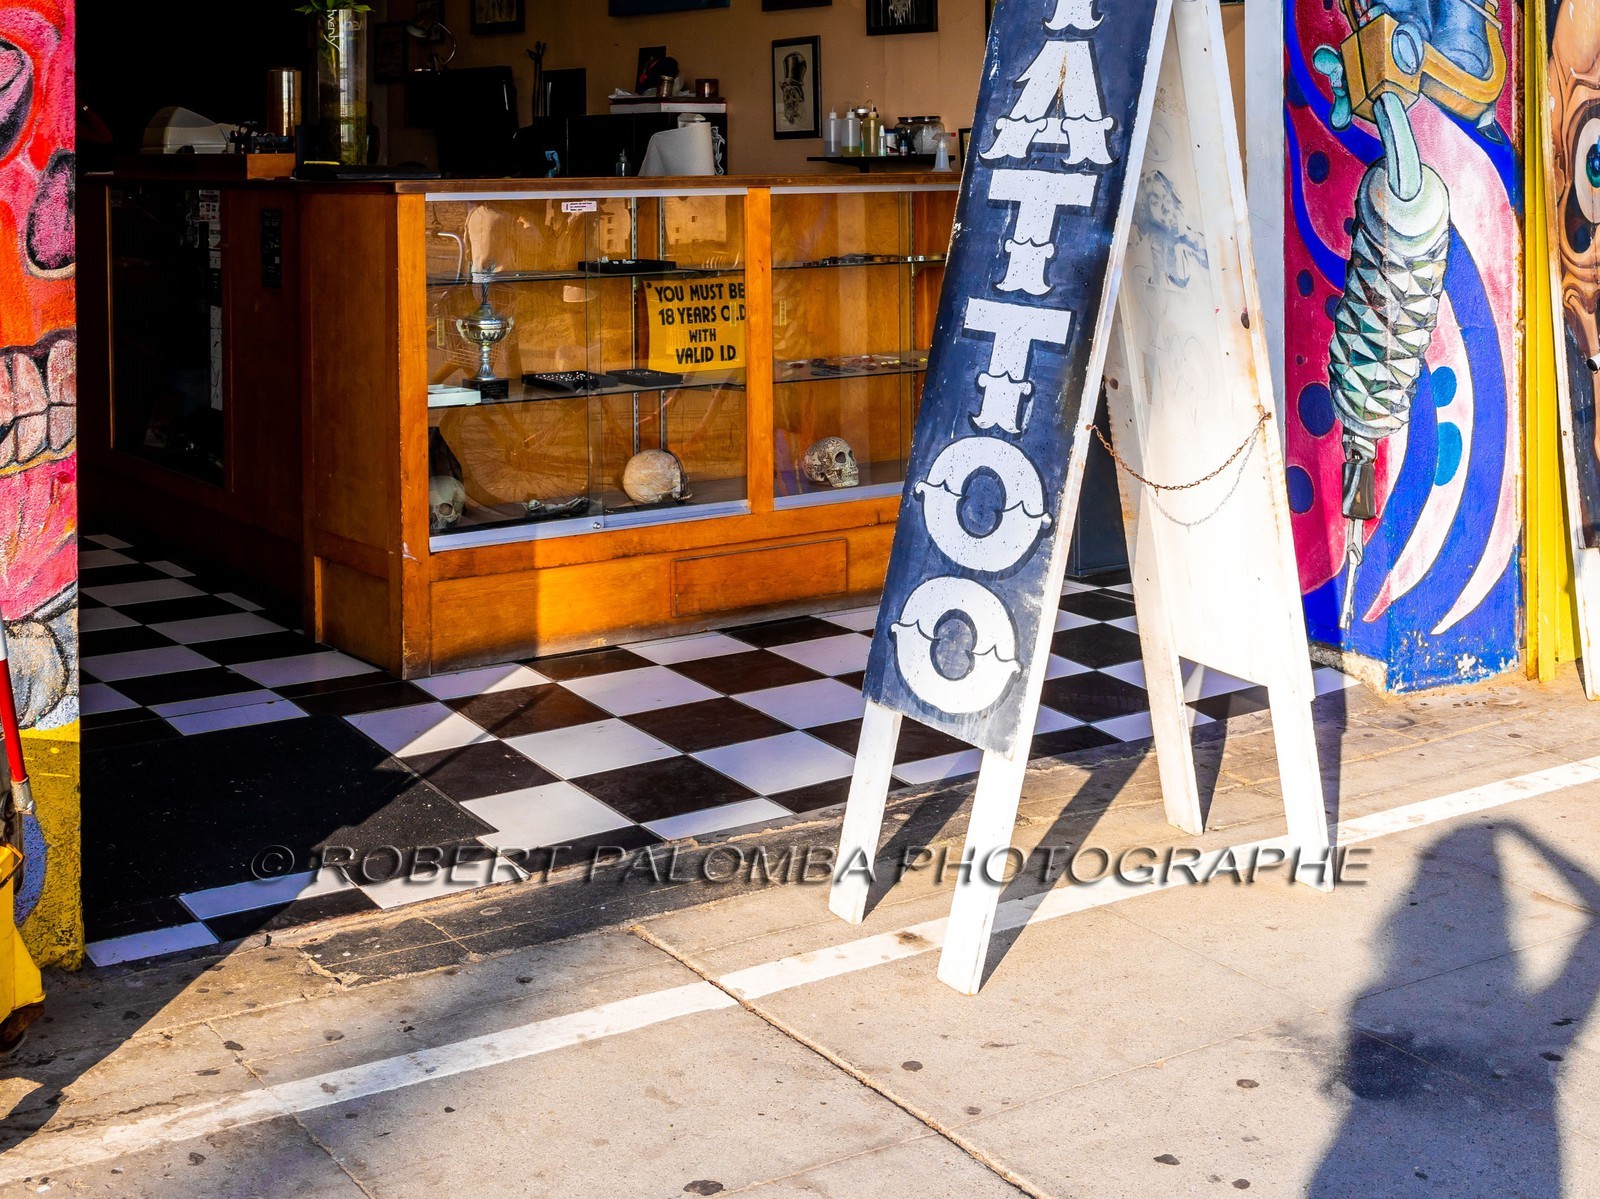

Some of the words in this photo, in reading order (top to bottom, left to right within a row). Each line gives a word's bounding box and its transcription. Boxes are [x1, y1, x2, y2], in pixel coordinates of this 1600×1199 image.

[654, 285, 684, 303] YOU
[689, 283, 724, 301] MUST
[728, 282, 745, 299] BE
[658, 308, 675, 325] 18
[677, 305, 717, 324] YEARS
[720, 303, 746, 322] OD
[689, 328, 717, 343] WITH
[675, 346, 714, 364] VALID
